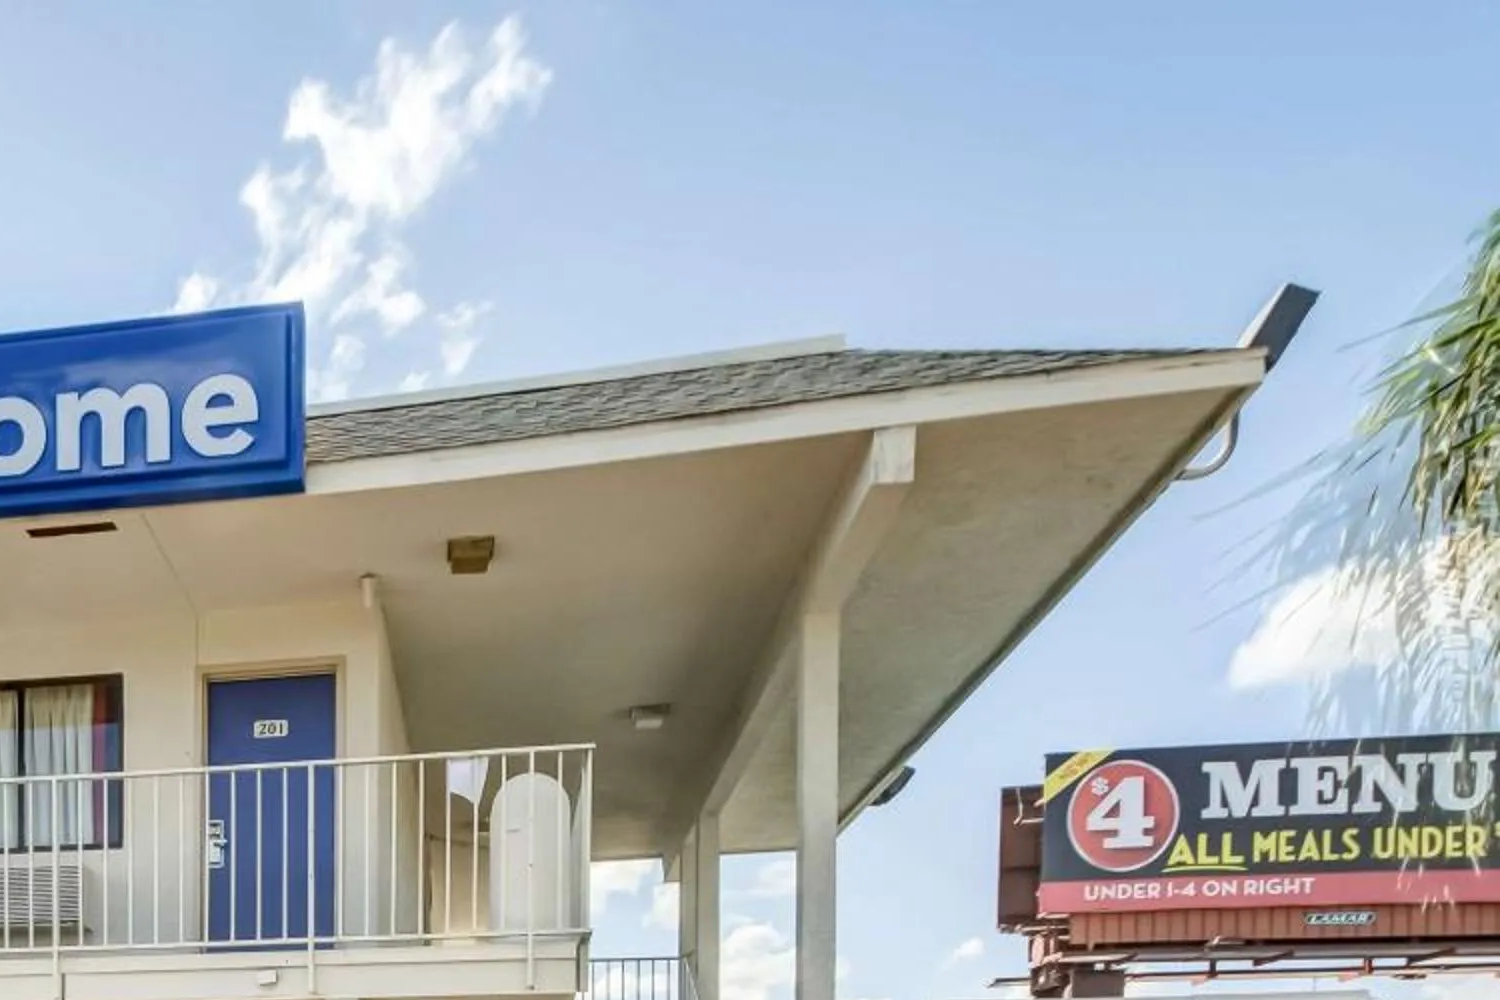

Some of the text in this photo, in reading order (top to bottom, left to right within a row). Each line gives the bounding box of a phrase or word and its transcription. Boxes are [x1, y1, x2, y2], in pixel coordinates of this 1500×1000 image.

[259, 722, 283, 735] 201
[1201, 751, 1497, 819] MENU
[1167, 823, 1488, 866] ALL MEALS UNDER
[1084, 882, 1160, 901] UNDER
[1202, 880, 1238, 897] ON
[1243, 877, 1316, 896] RIGHT
